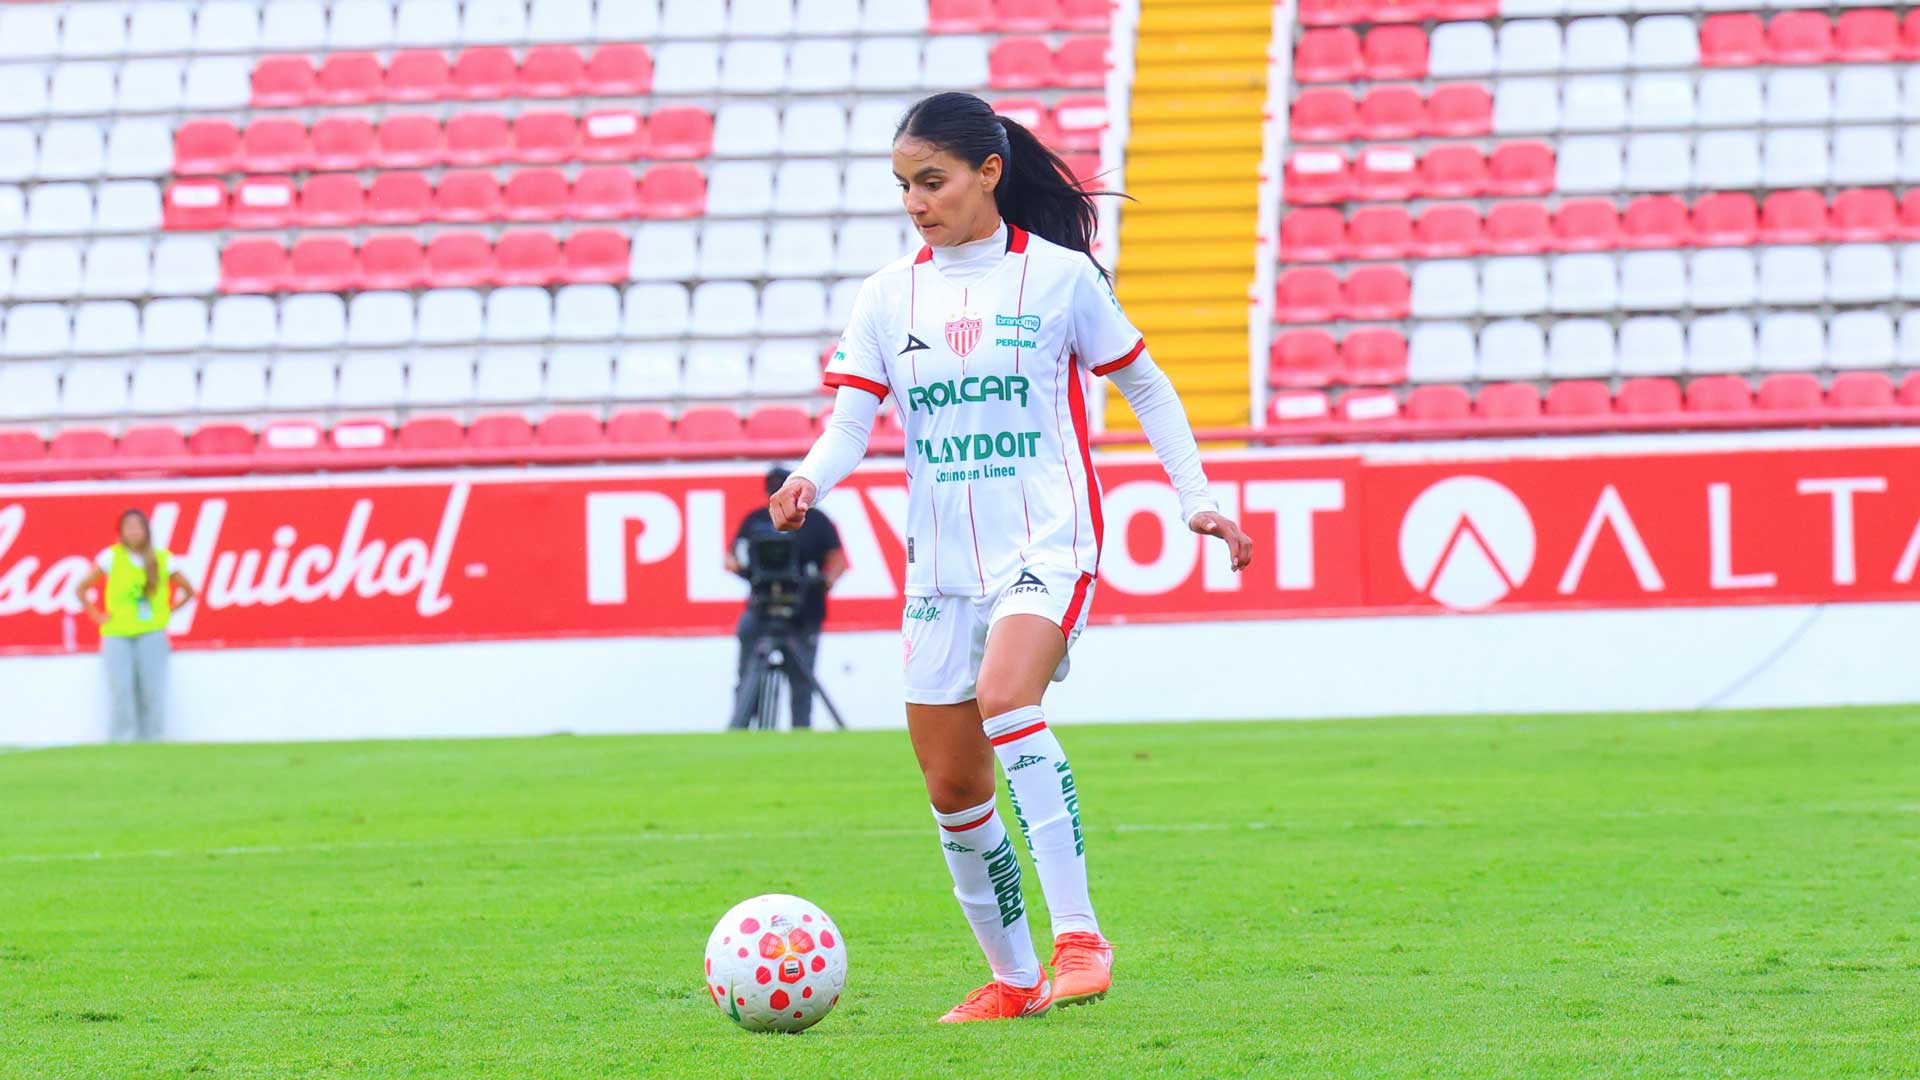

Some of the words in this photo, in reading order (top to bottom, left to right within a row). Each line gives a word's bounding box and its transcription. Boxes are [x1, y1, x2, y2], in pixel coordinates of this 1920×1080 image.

[996, 338, 1037, 349] PERDURA
[908, 375, 1030, 415] ROLCAR
[936, 468, 966, 482] Casino
[983, 463, 1016, 479] Línea
[984, 832, 1025, 929] PERDURA
